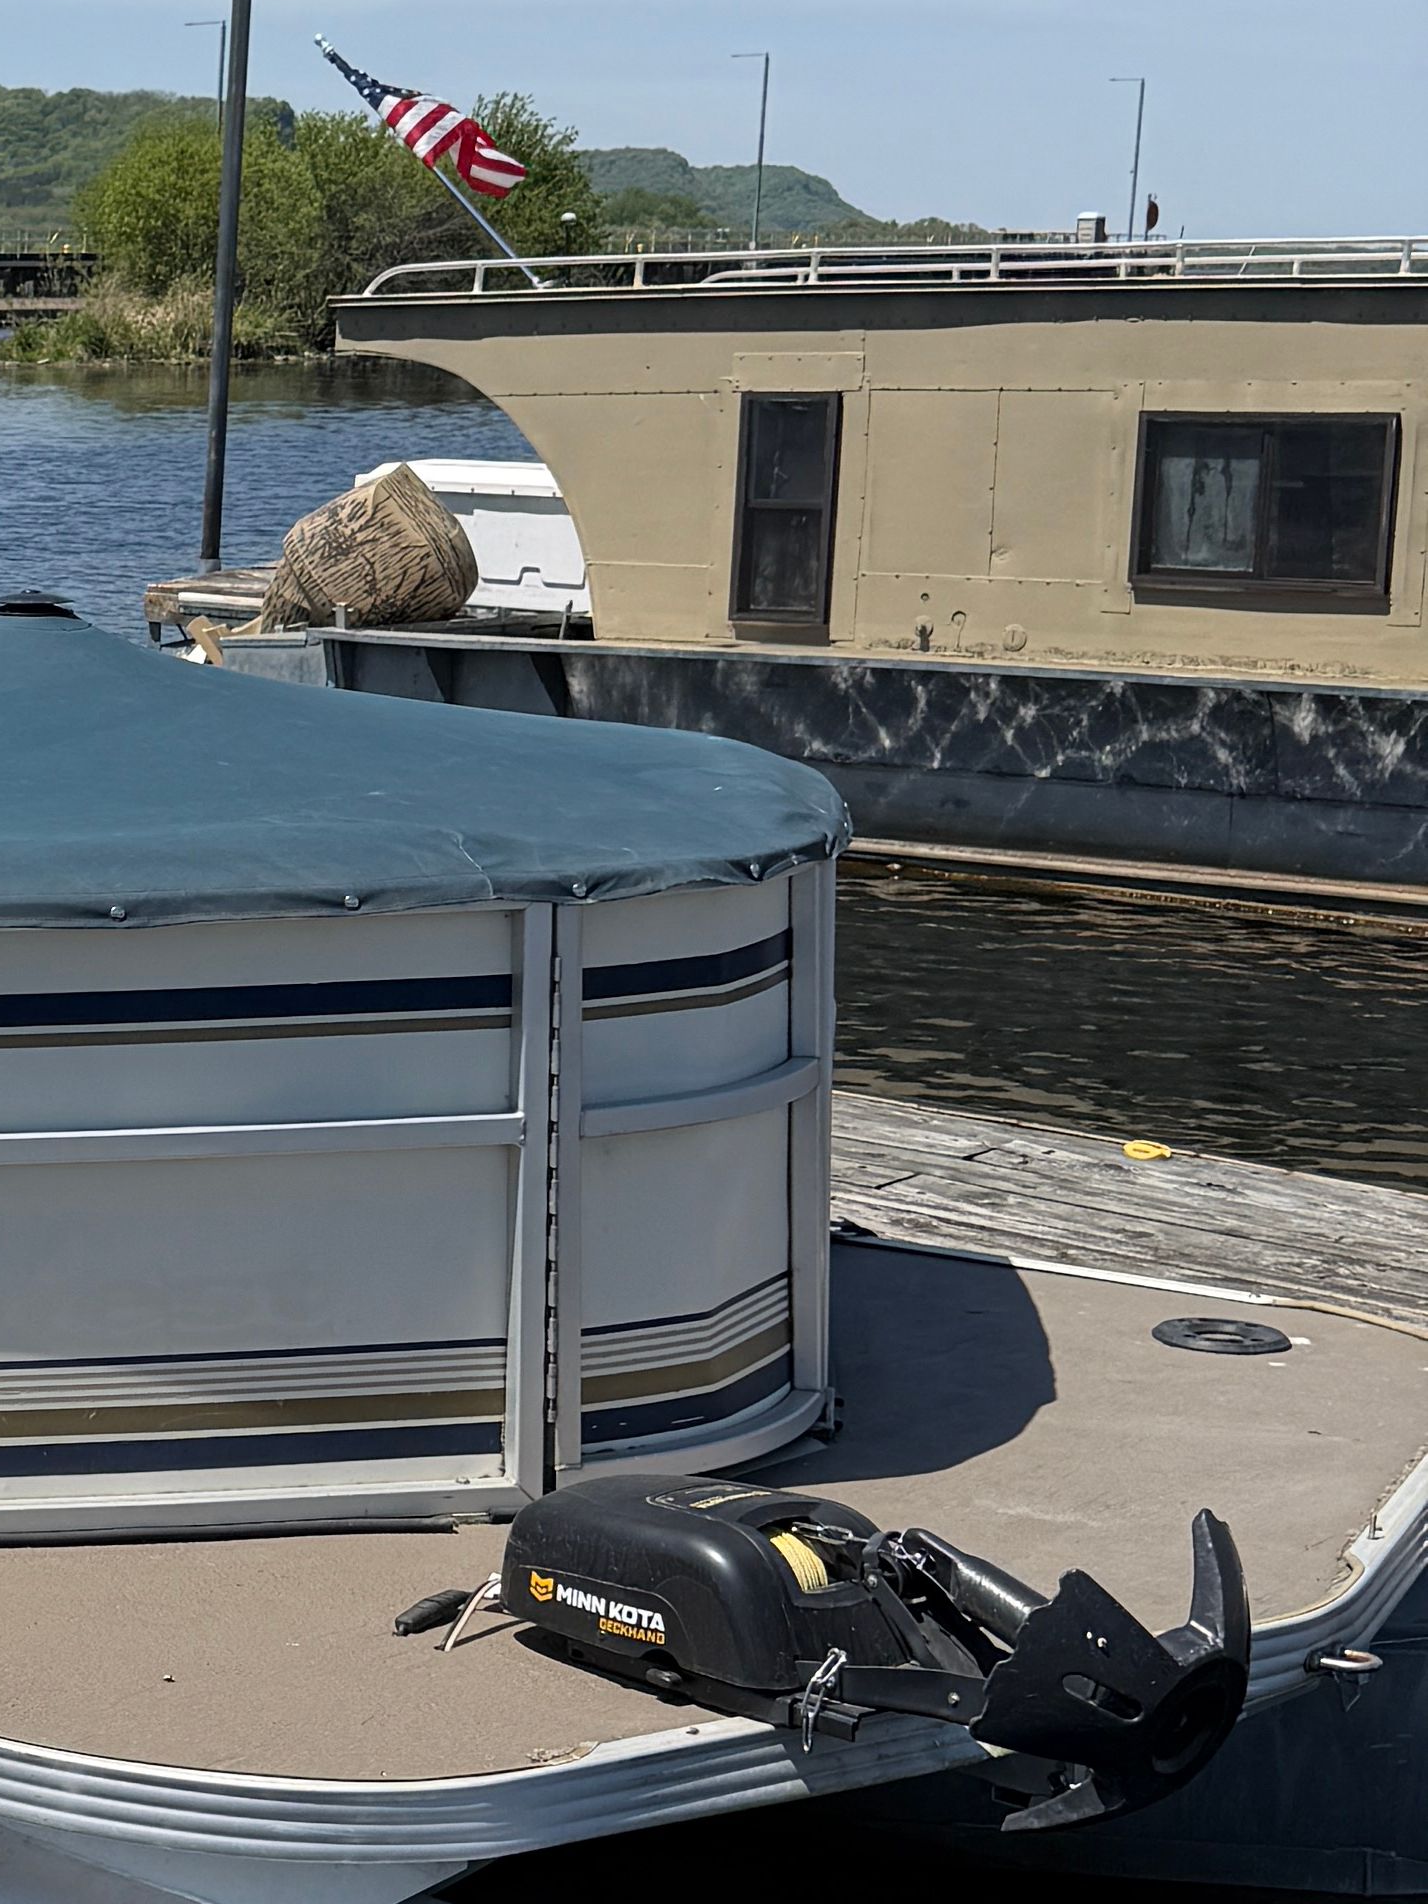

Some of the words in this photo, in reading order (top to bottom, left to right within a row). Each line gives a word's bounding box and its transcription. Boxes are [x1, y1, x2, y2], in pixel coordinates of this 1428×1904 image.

[556, 1583, 606, 1616] MINN
[609, 1600, 666, 1632] KOTA
[599, 1617, 665, 1645] DECKHAND
